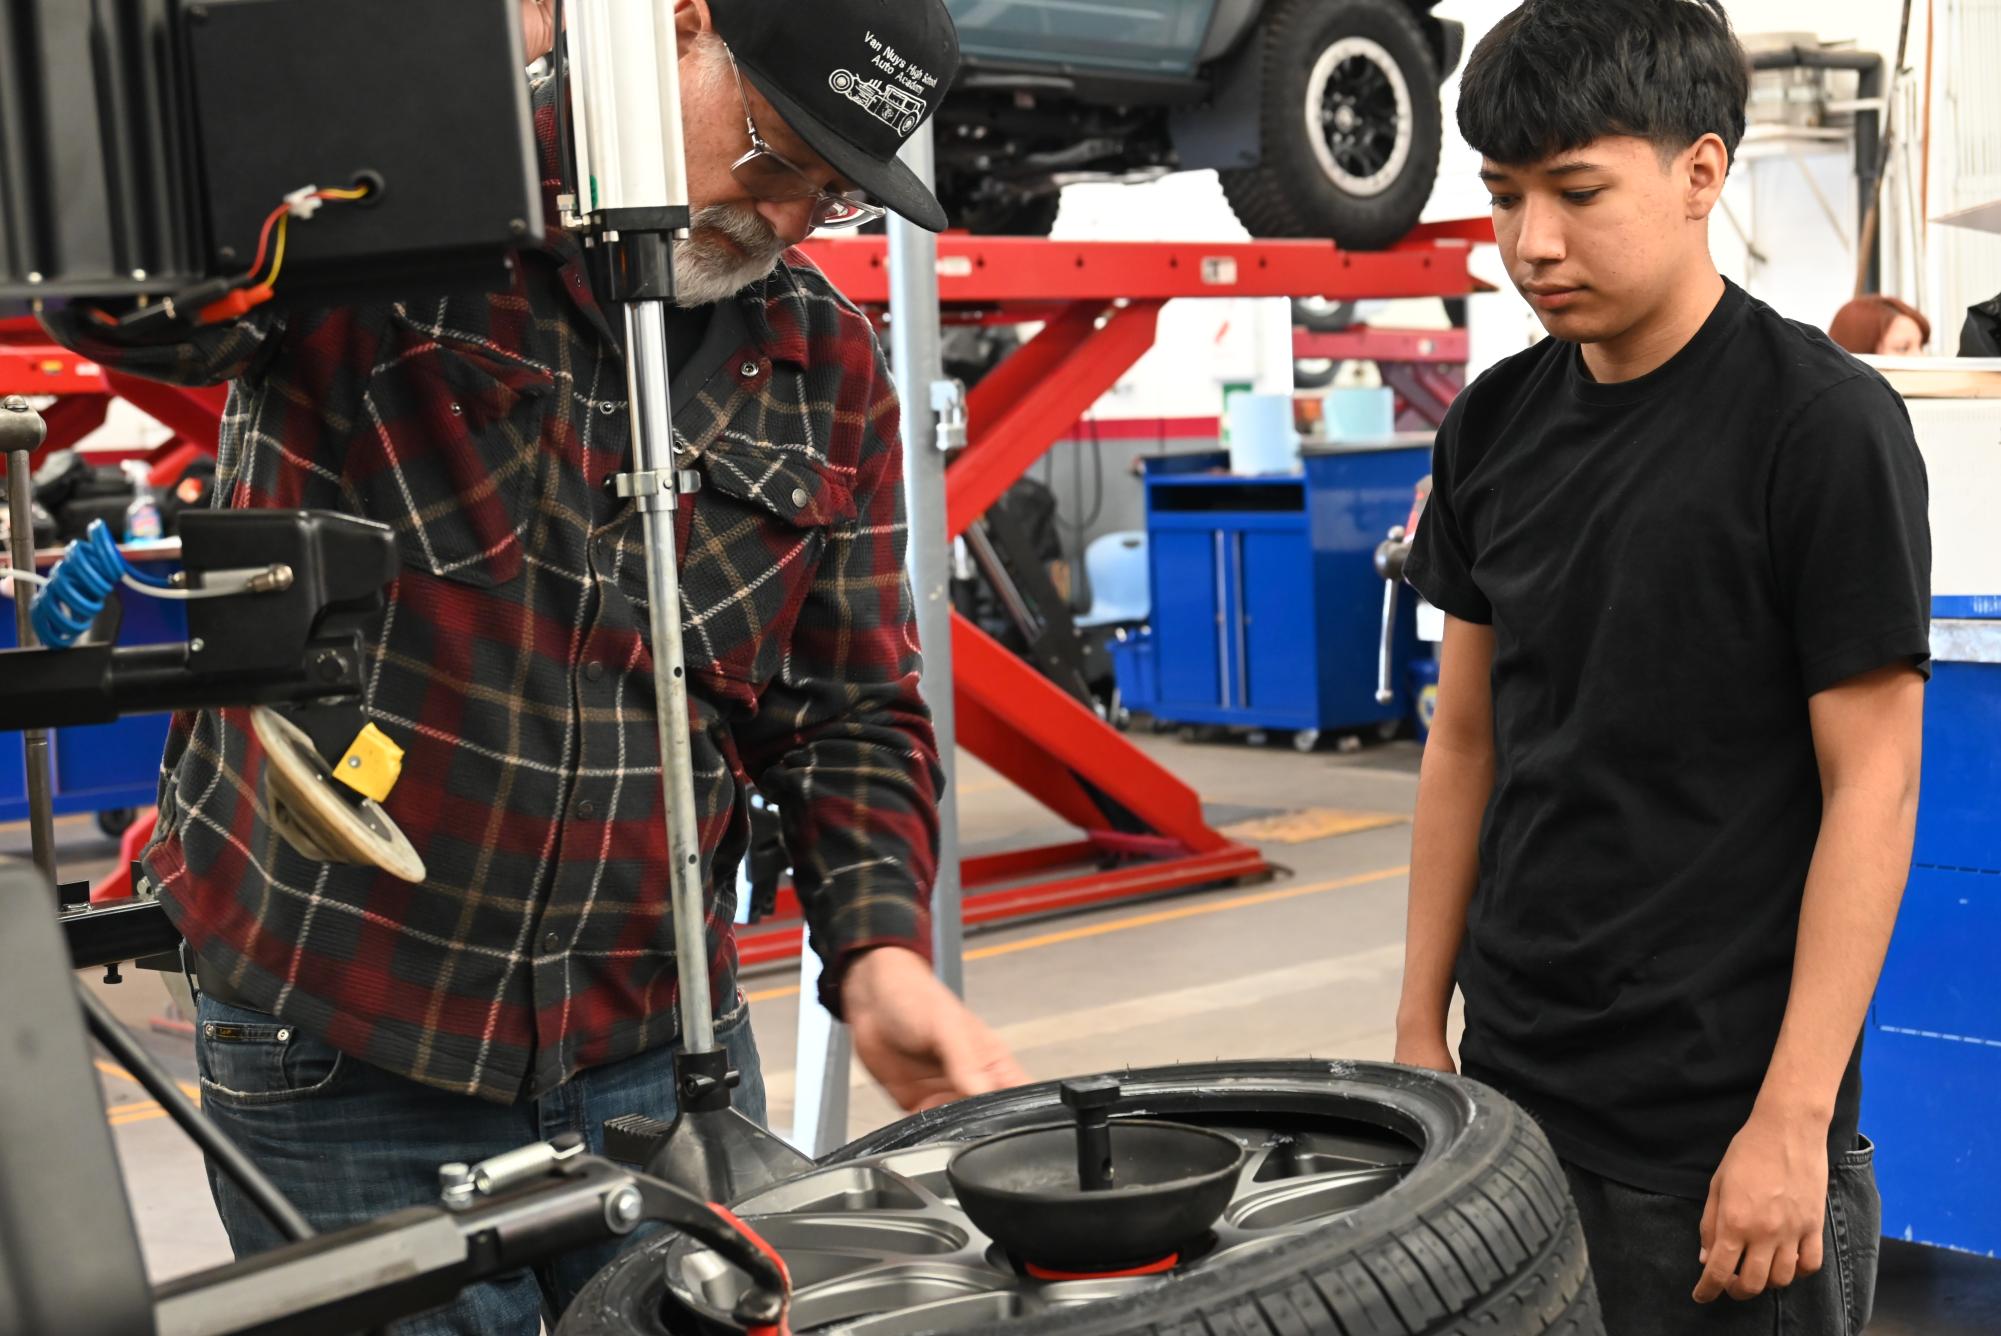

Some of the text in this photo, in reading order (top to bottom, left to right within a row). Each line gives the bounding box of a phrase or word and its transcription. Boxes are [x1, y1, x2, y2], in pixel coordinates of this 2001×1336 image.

[864, 30, 882, 51] Van
[883, 46, 906, 68] Nuys
[906, 64, 923, 80] High
[871, 54, 894, 74] Auto
